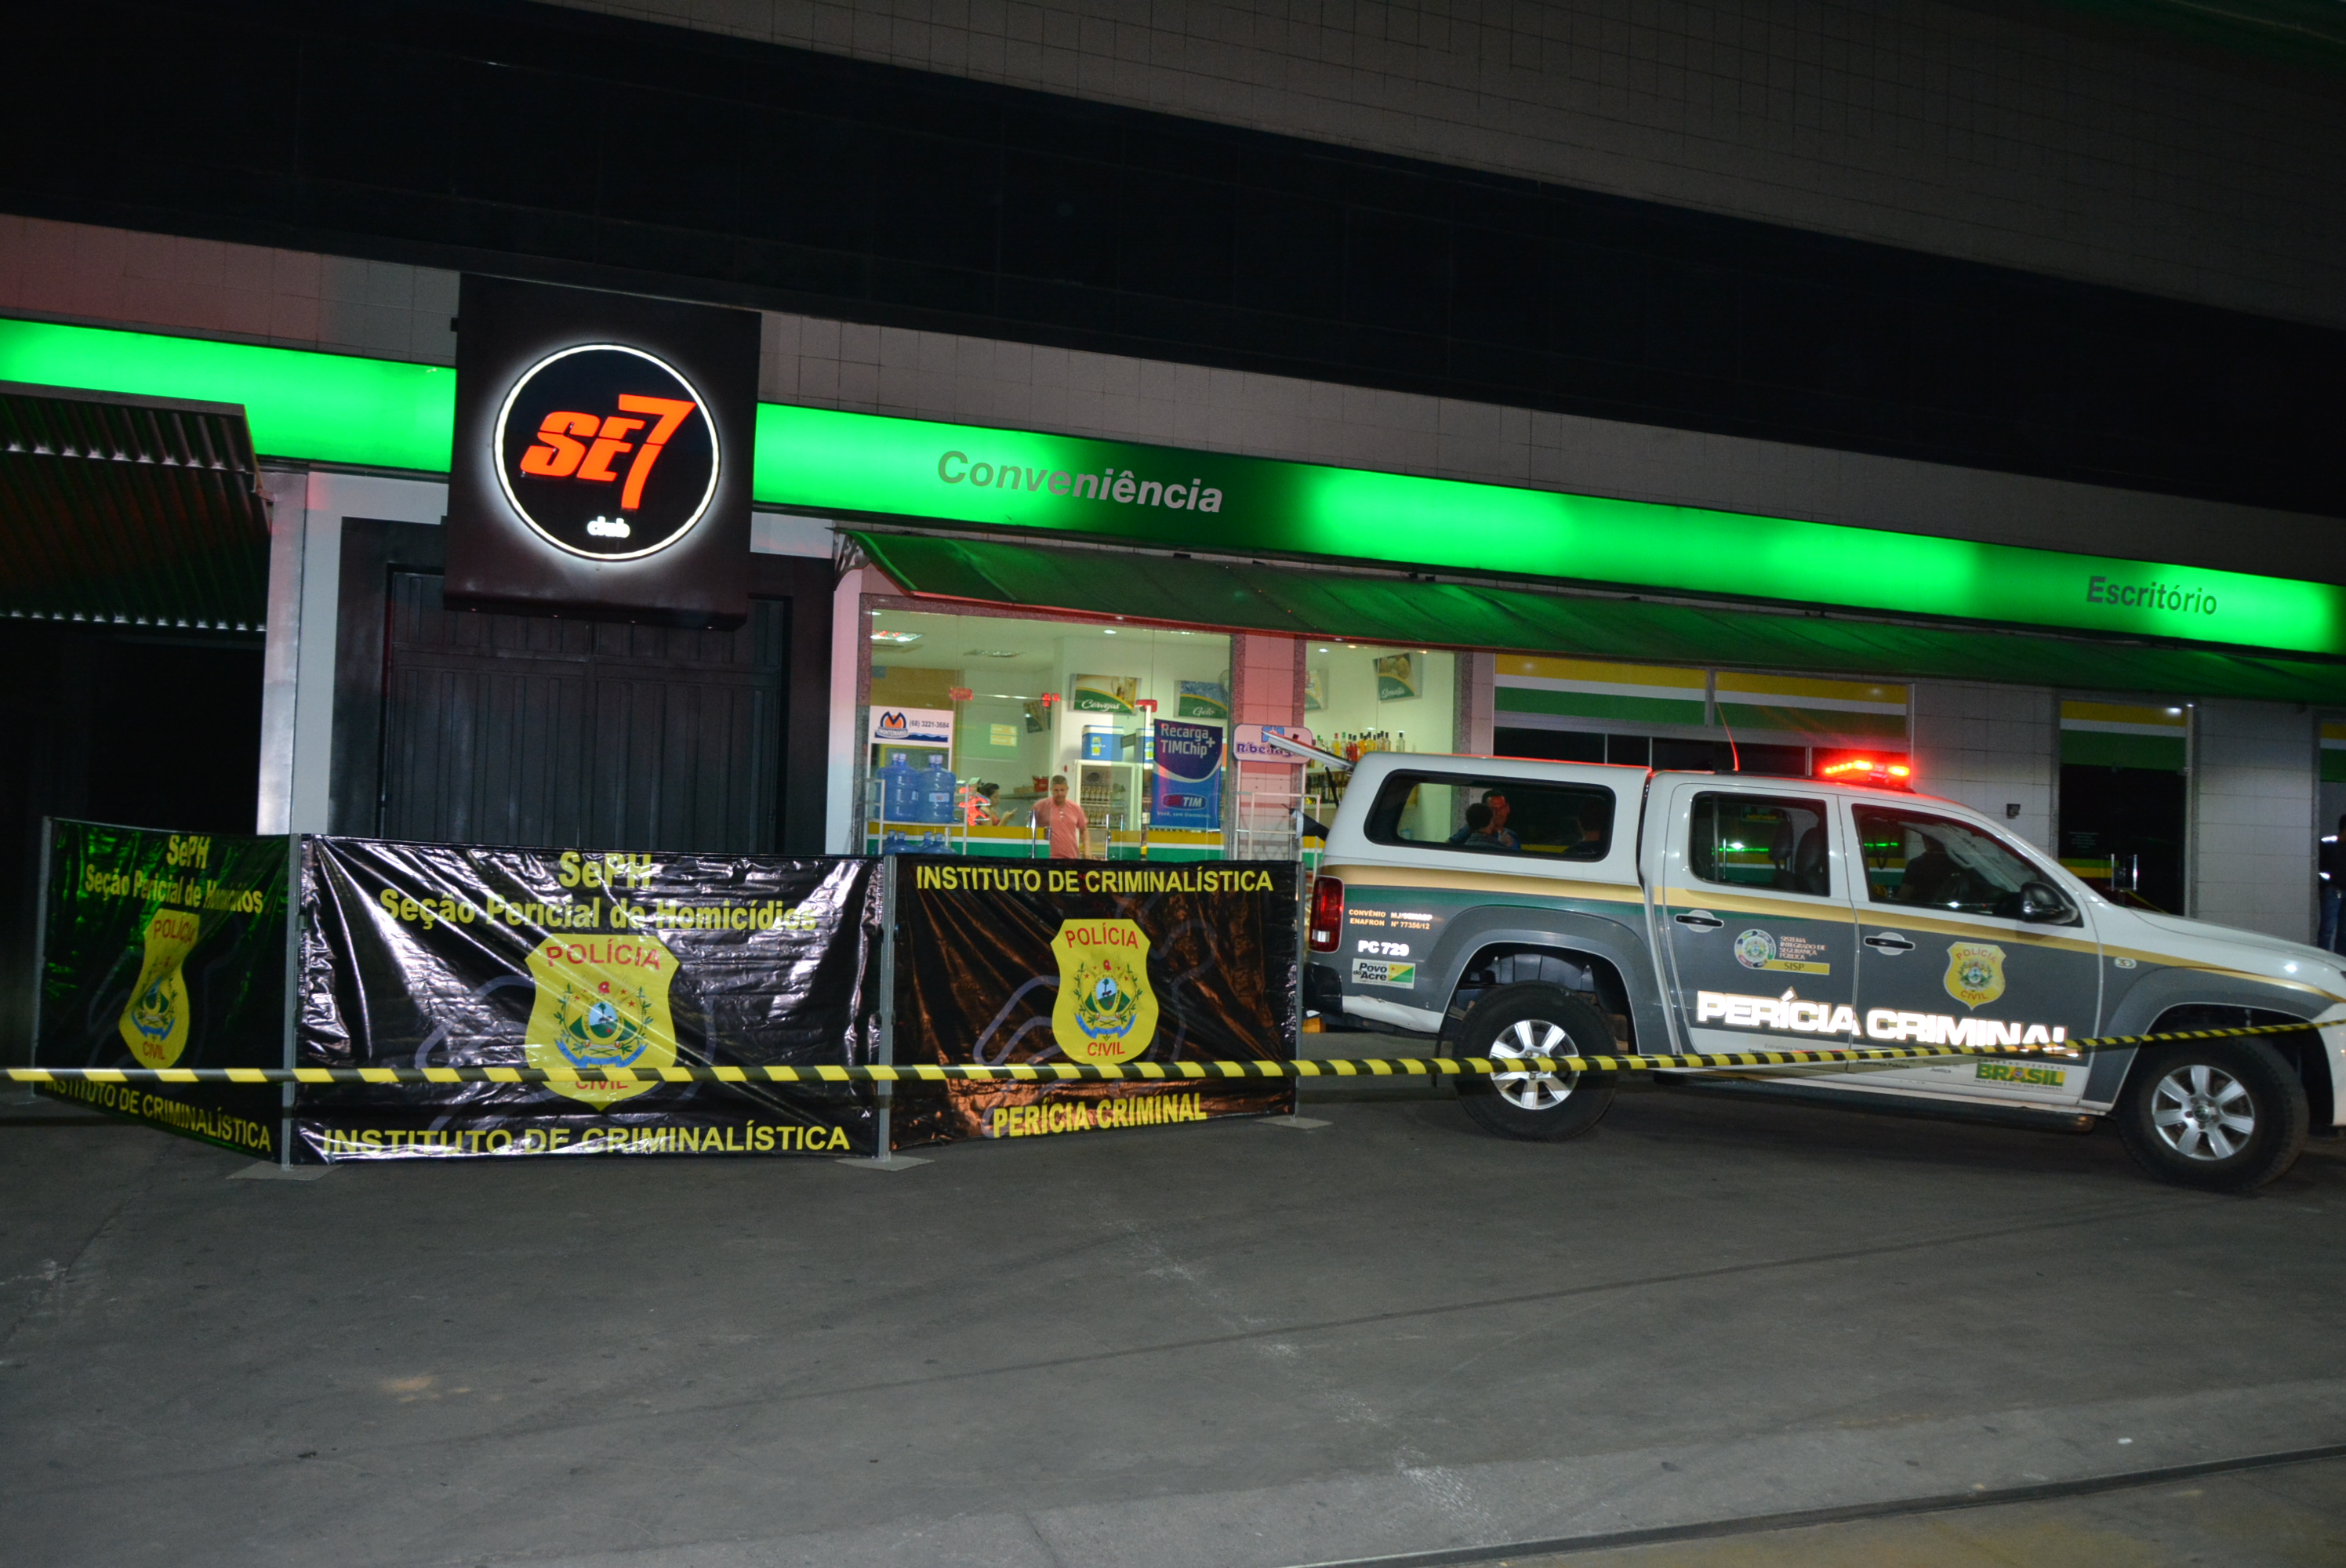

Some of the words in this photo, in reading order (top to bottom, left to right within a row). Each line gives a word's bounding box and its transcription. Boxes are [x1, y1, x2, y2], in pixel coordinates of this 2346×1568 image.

[520, 394, 696, 510] SE7
[937, 450, 1223, 513] Conveniência
[2086, 575, 2217, 615] Escritório
[1193, 706, 1215, 717] Gelo
[1160, 723, 1209, 742] Recarga
[1160, 739, 1208, 759] TIMChip
[1182, 797, 1203, 808] TIM
[166, 834, 212, 869] SePH
[558, 851, 652, 888] SePH
[916, 866, 1041, 892] INSTITUTO
[1049, 870, 1080, 892] DE
[1084, 866, 1274, 892] CRIMINALÍSTICA
[85, 863, 130, 902] Seção
[133, 869, 184, 905] Pericial
[185, 877, 202, 907] de
[380, 889, 475, 930] Seção
[486, 894, 601, 928] Pericial
[609, 898, 645, 929] de
[656, 899, 817, 931] Homicídios
[1349, 909, 1386, 918] CONVÊNIO
[1065, 923, 1138, 949] POLÍCIA
[1357, 940, 1379, 953] PC
[547, 938, 661, 971] POLÍCIA
[1779, 947, 1818, 956] SEGURANÇA
[1956, 948, 1998, 964] POLÍCIA
[1359, 962, 1387, 973] Povo
[1360, 971, 1387, 981] Acre
[1784, 962, 1805, 971] SISP
[1960, 990, 1988, 1000] CIVIL
[1697, 985, 1865, 1038] PERÍCIA
[1866, 1007, 2070, 1049] CRIMINAL
[143, 1041, 167, 1061] CIVIL
[1087, 1041, 1126, 1058] CIVIL
[1976, 1063, 2066, 1087] BRASIL
[119, 1087, 140, 1114] DE
[142, 1094, 272, 1152] CRIMINALÍSTICA
[993, 1097, 1091, 1138] PERÍCIA
[1097, 1093, 1208, 1129] CRIMINAL
[323, 1129, 512, 1154] INSTITUTO
[524, 1128, 570, 1154] DE
[582, 1120, 851, 1153] CRIMINALÍSTICA
